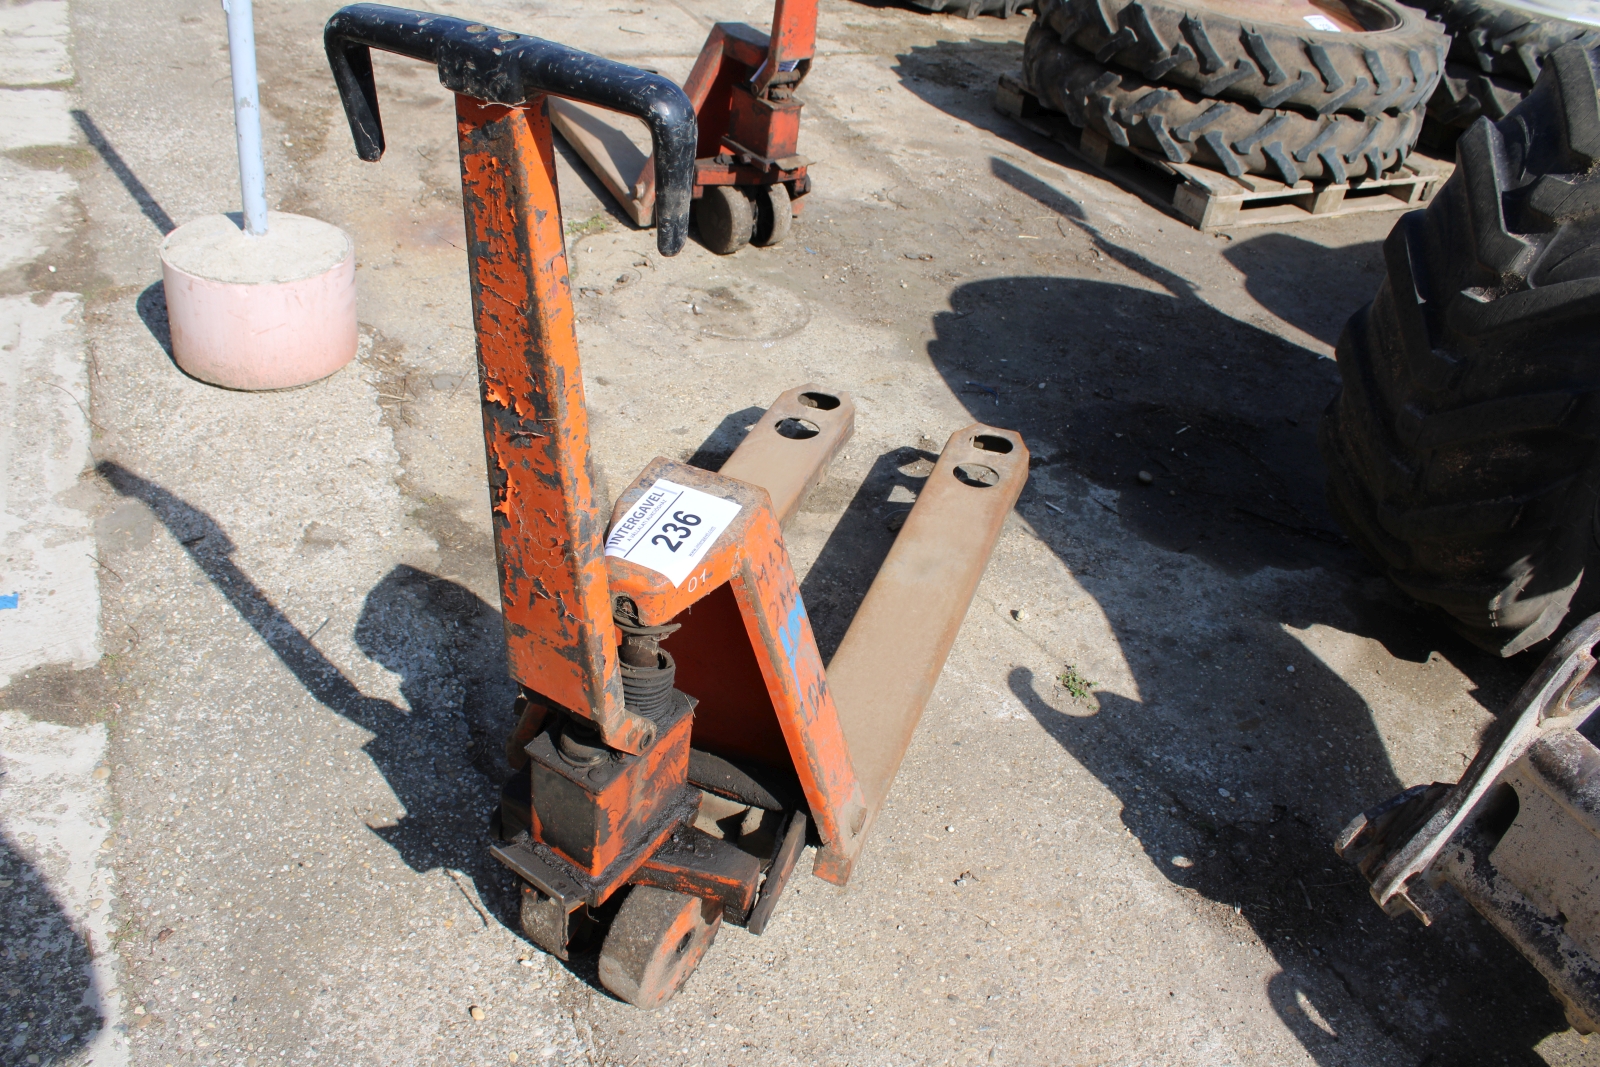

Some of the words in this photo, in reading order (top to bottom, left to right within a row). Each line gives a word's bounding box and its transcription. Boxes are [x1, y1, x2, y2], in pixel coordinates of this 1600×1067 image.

[608, 492, 665, 545] INTERGAVEL
[651, 510, 702, 553] 236
[688, 568, 707, 593] 01
